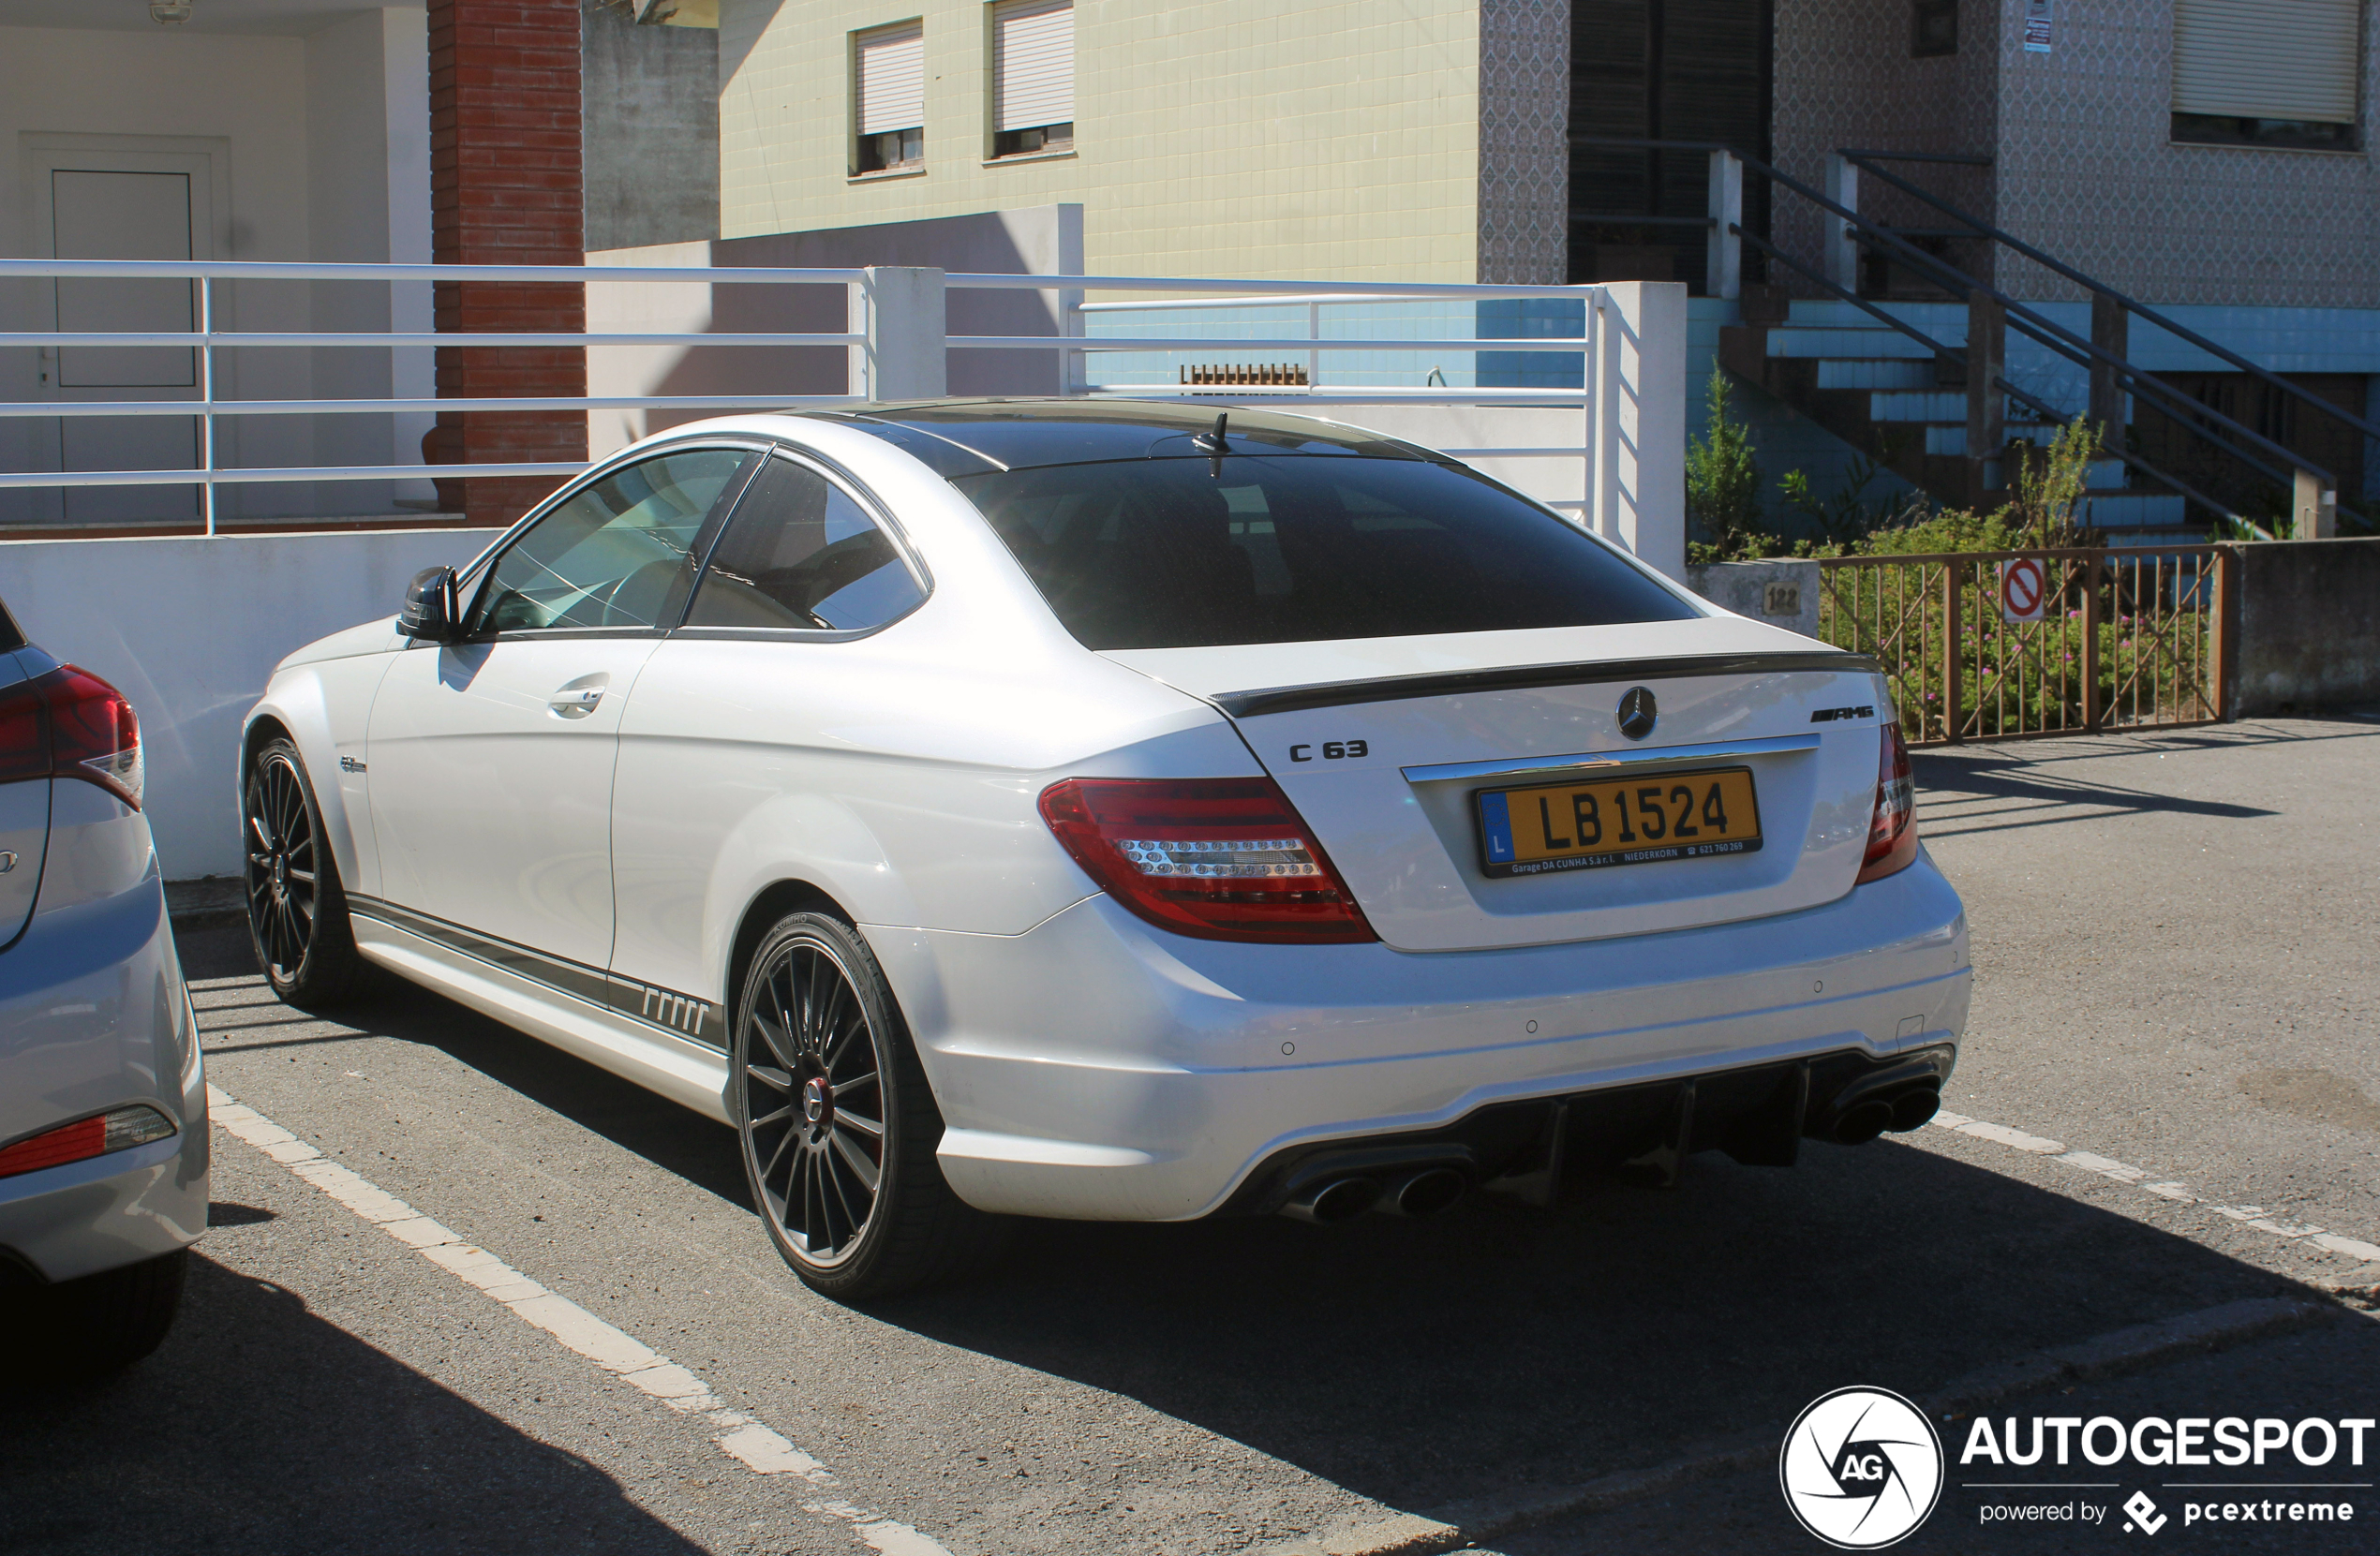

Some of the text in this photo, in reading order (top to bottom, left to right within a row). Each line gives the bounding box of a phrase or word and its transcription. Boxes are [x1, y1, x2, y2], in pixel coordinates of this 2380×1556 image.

[1768, 586, 1797, 610] 122
[1832, 705, 1874, 720] AMG
[1289, 740, 1368, 763] C 63
[1493, 836, 1505, 853] L
[1512, 864, 1541, 873] Garage
[1542, 861, 1555, 870] DA
[1556, 857, 1588, 868] CUNHA
[1624, 849, 1678, 861] NIEDERKORN
[1699, 845, 1713, 853] 621
[1715, 843, 1729, 852] 760
[1730, 841, 1743, 851] 269
